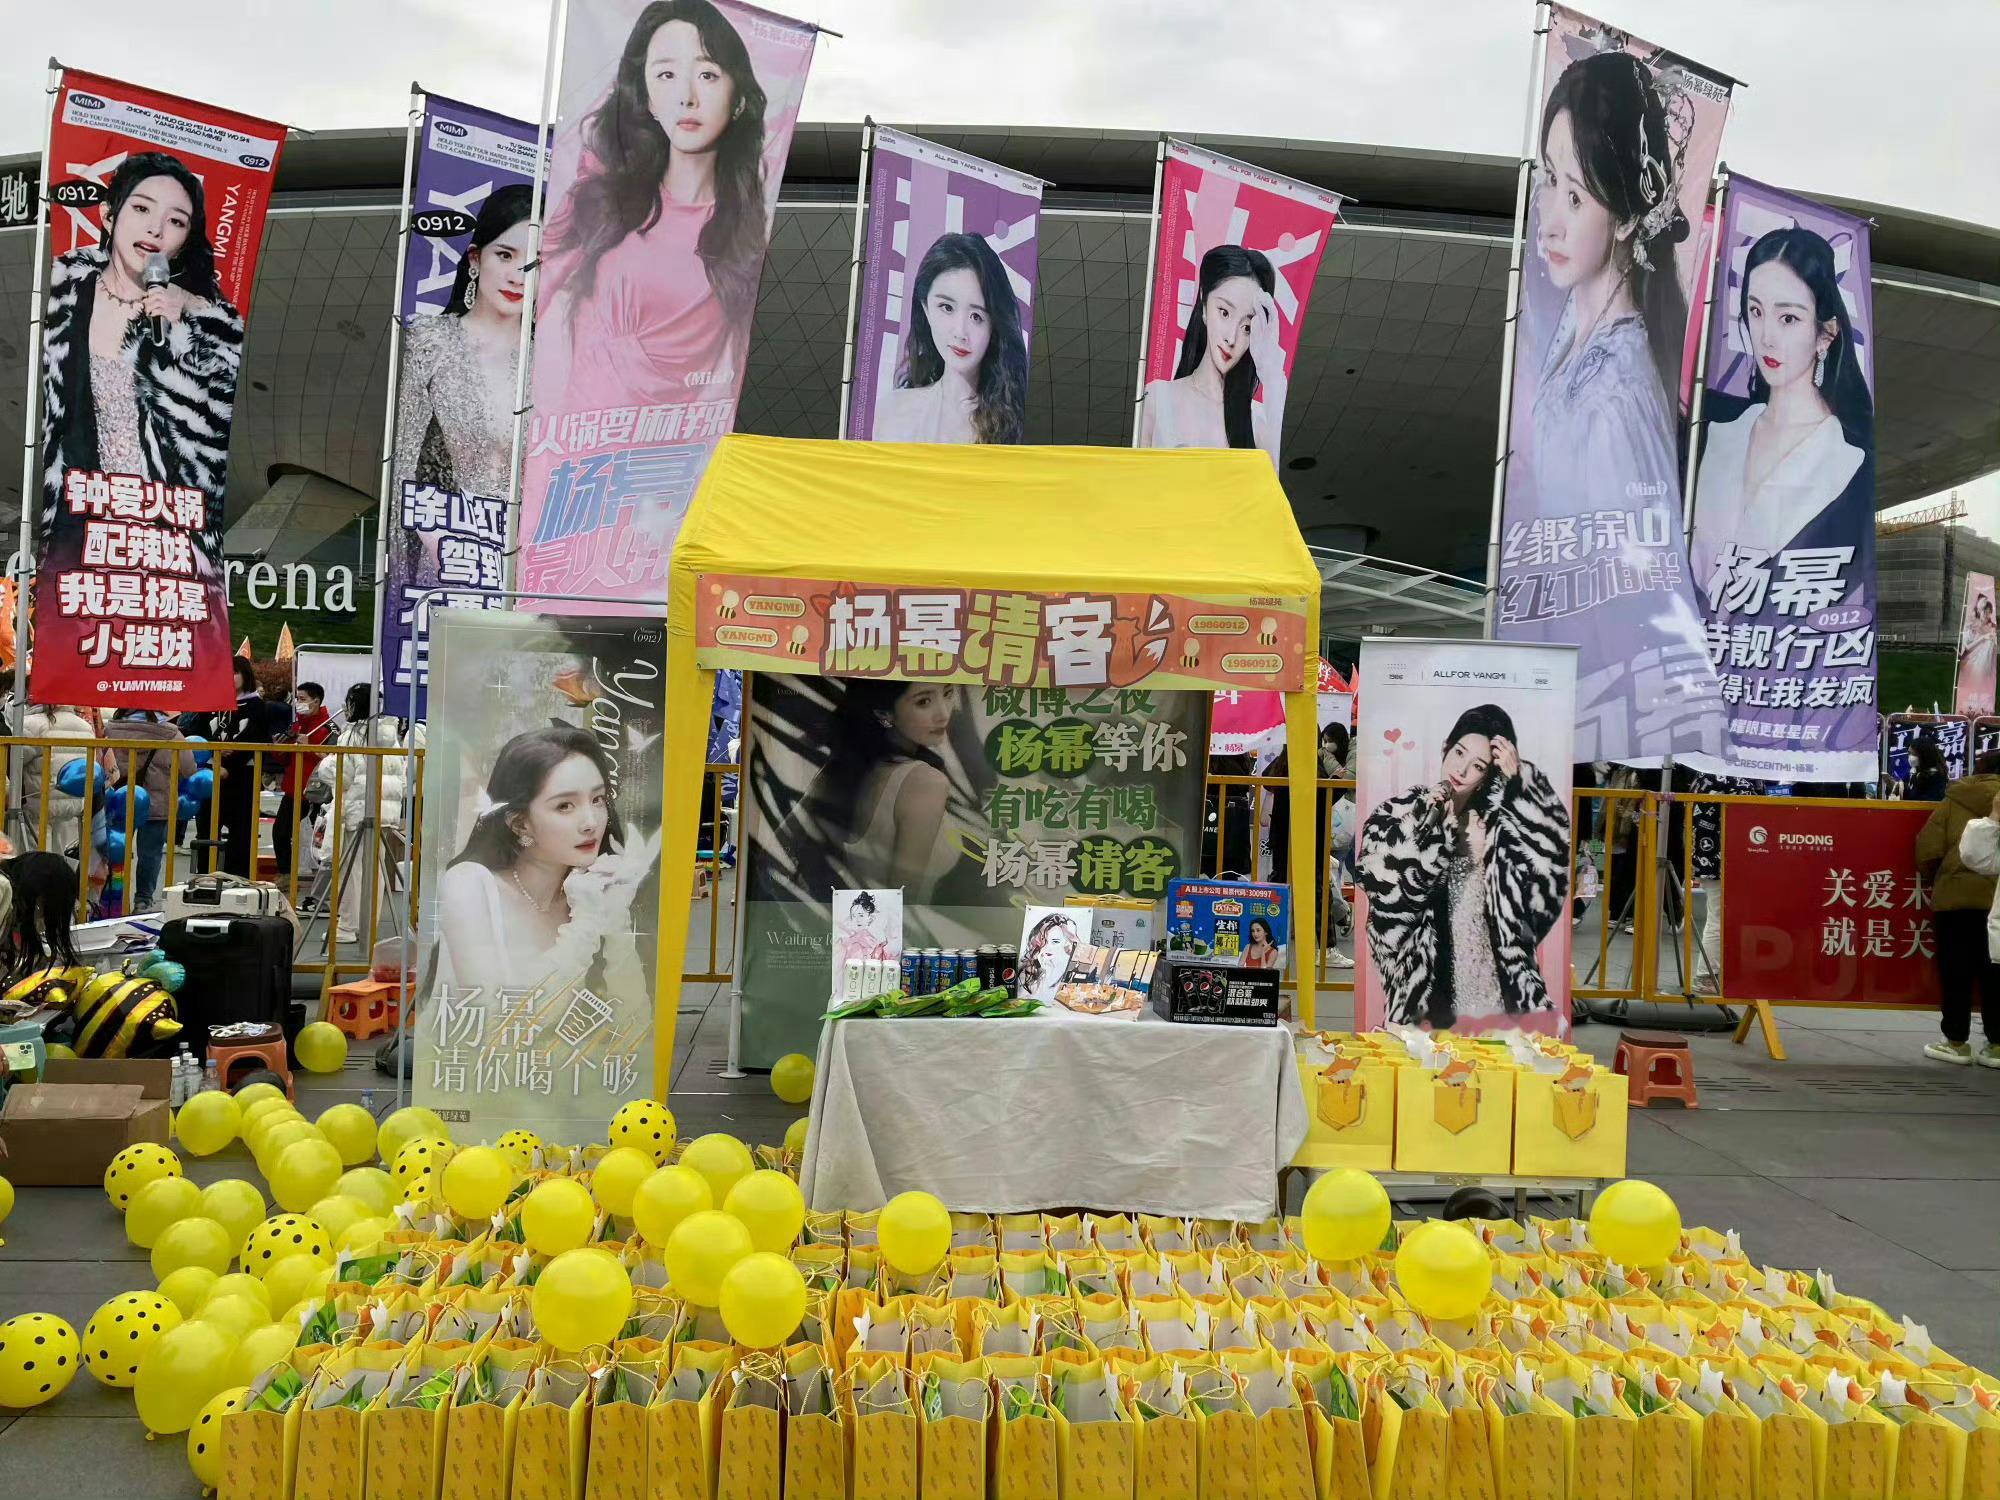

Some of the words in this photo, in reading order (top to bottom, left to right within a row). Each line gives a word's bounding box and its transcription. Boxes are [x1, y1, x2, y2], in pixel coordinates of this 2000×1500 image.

[74, 95, 101, 109] MIMI
[154, 119, 175, 129] YANG
[439, 122, 464, 136] MIMI
[243, 155, 265, 167] 0912
[1227, 165, 1240, 173] ALL
[1253, 173, 1269, 183] YANG
[57, 185, 99, 201] 0912
[213, 183, 242, 259] YANGMI
[417, 215, 466, 232] 0912
[529, 398, 736, 457] 火锅要麻辣
[66, 469, 206, 531] 钟爱火锅
[531, 442, 707, 545] 杨幂
[1625, 481, 1668, 498] (Mini)
[404, 483, 507, 545] 涂山红
[85, 520, 193, 574] 配辣妹
[1502, 507, 1671, 569] 缘聚涂山
[59, 570, 208, 623] 我是杨幂
[1708, 541, 1856, 617] 杨幂
[748, 600, 801, 612] YANGMI
[1193, 620, 1245, 630] 19860912
[1818, 610, 1860, 626] 0912
[81, 623, 193, 670] 小迷妹
[721, 632, 773, 643] YANGMI
[825, 595, 1112, 686] 杨幂请客
[1226, 659, 1279, 668] 19860912
[997, 721, 1188, 772] 杨幂等你
[984, 784, 1158, 832] 有吃有喝
[1779, 833, 1834, 846] PUDONG
[981, 837, 1174, 891] 杨幂请客
[767, 931, 823, 947] Waiting
[1821, 917, 1936, 960] 就是关
[432, 983, 545, 1049] 杨幂
[432, 1045, 639, 1097] 请你喝个够
